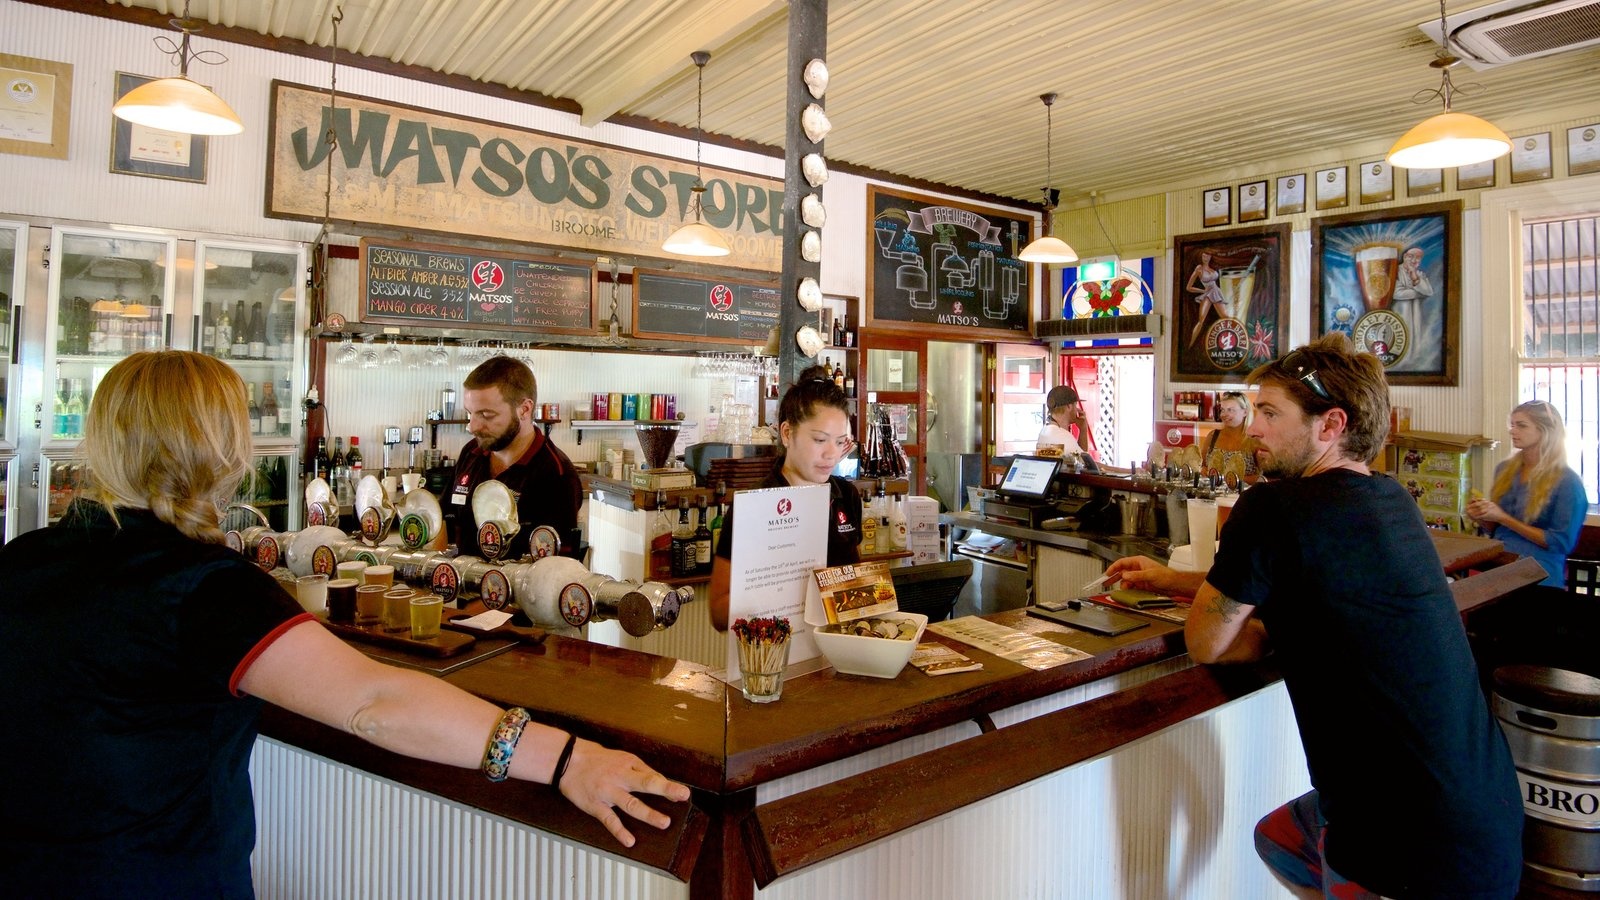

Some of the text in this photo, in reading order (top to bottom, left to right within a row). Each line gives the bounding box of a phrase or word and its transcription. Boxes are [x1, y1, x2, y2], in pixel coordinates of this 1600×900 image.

[291, 106, 612, 210] MATSO'S
[934, 208, 977, 229] BREWERY
[551, 220, 616, 239] BROOME
[370, 299, 406, 314] MANGO
[469, 292, 512, 304] MATSO'S
[705, 311, 739, 322] MATSO'S
[937, 313, 979, 326] MATSO'S
[1208, 320, 1247, 346] GINGER BEER
[1355, 314, 1404, 351] SMOKEY BISHOP
[768, 517, 800, 526] MATSO'S
[816, 565, 855, 581] VOTE FOR OUR
[1525, 781, 1599, 815] BRO
